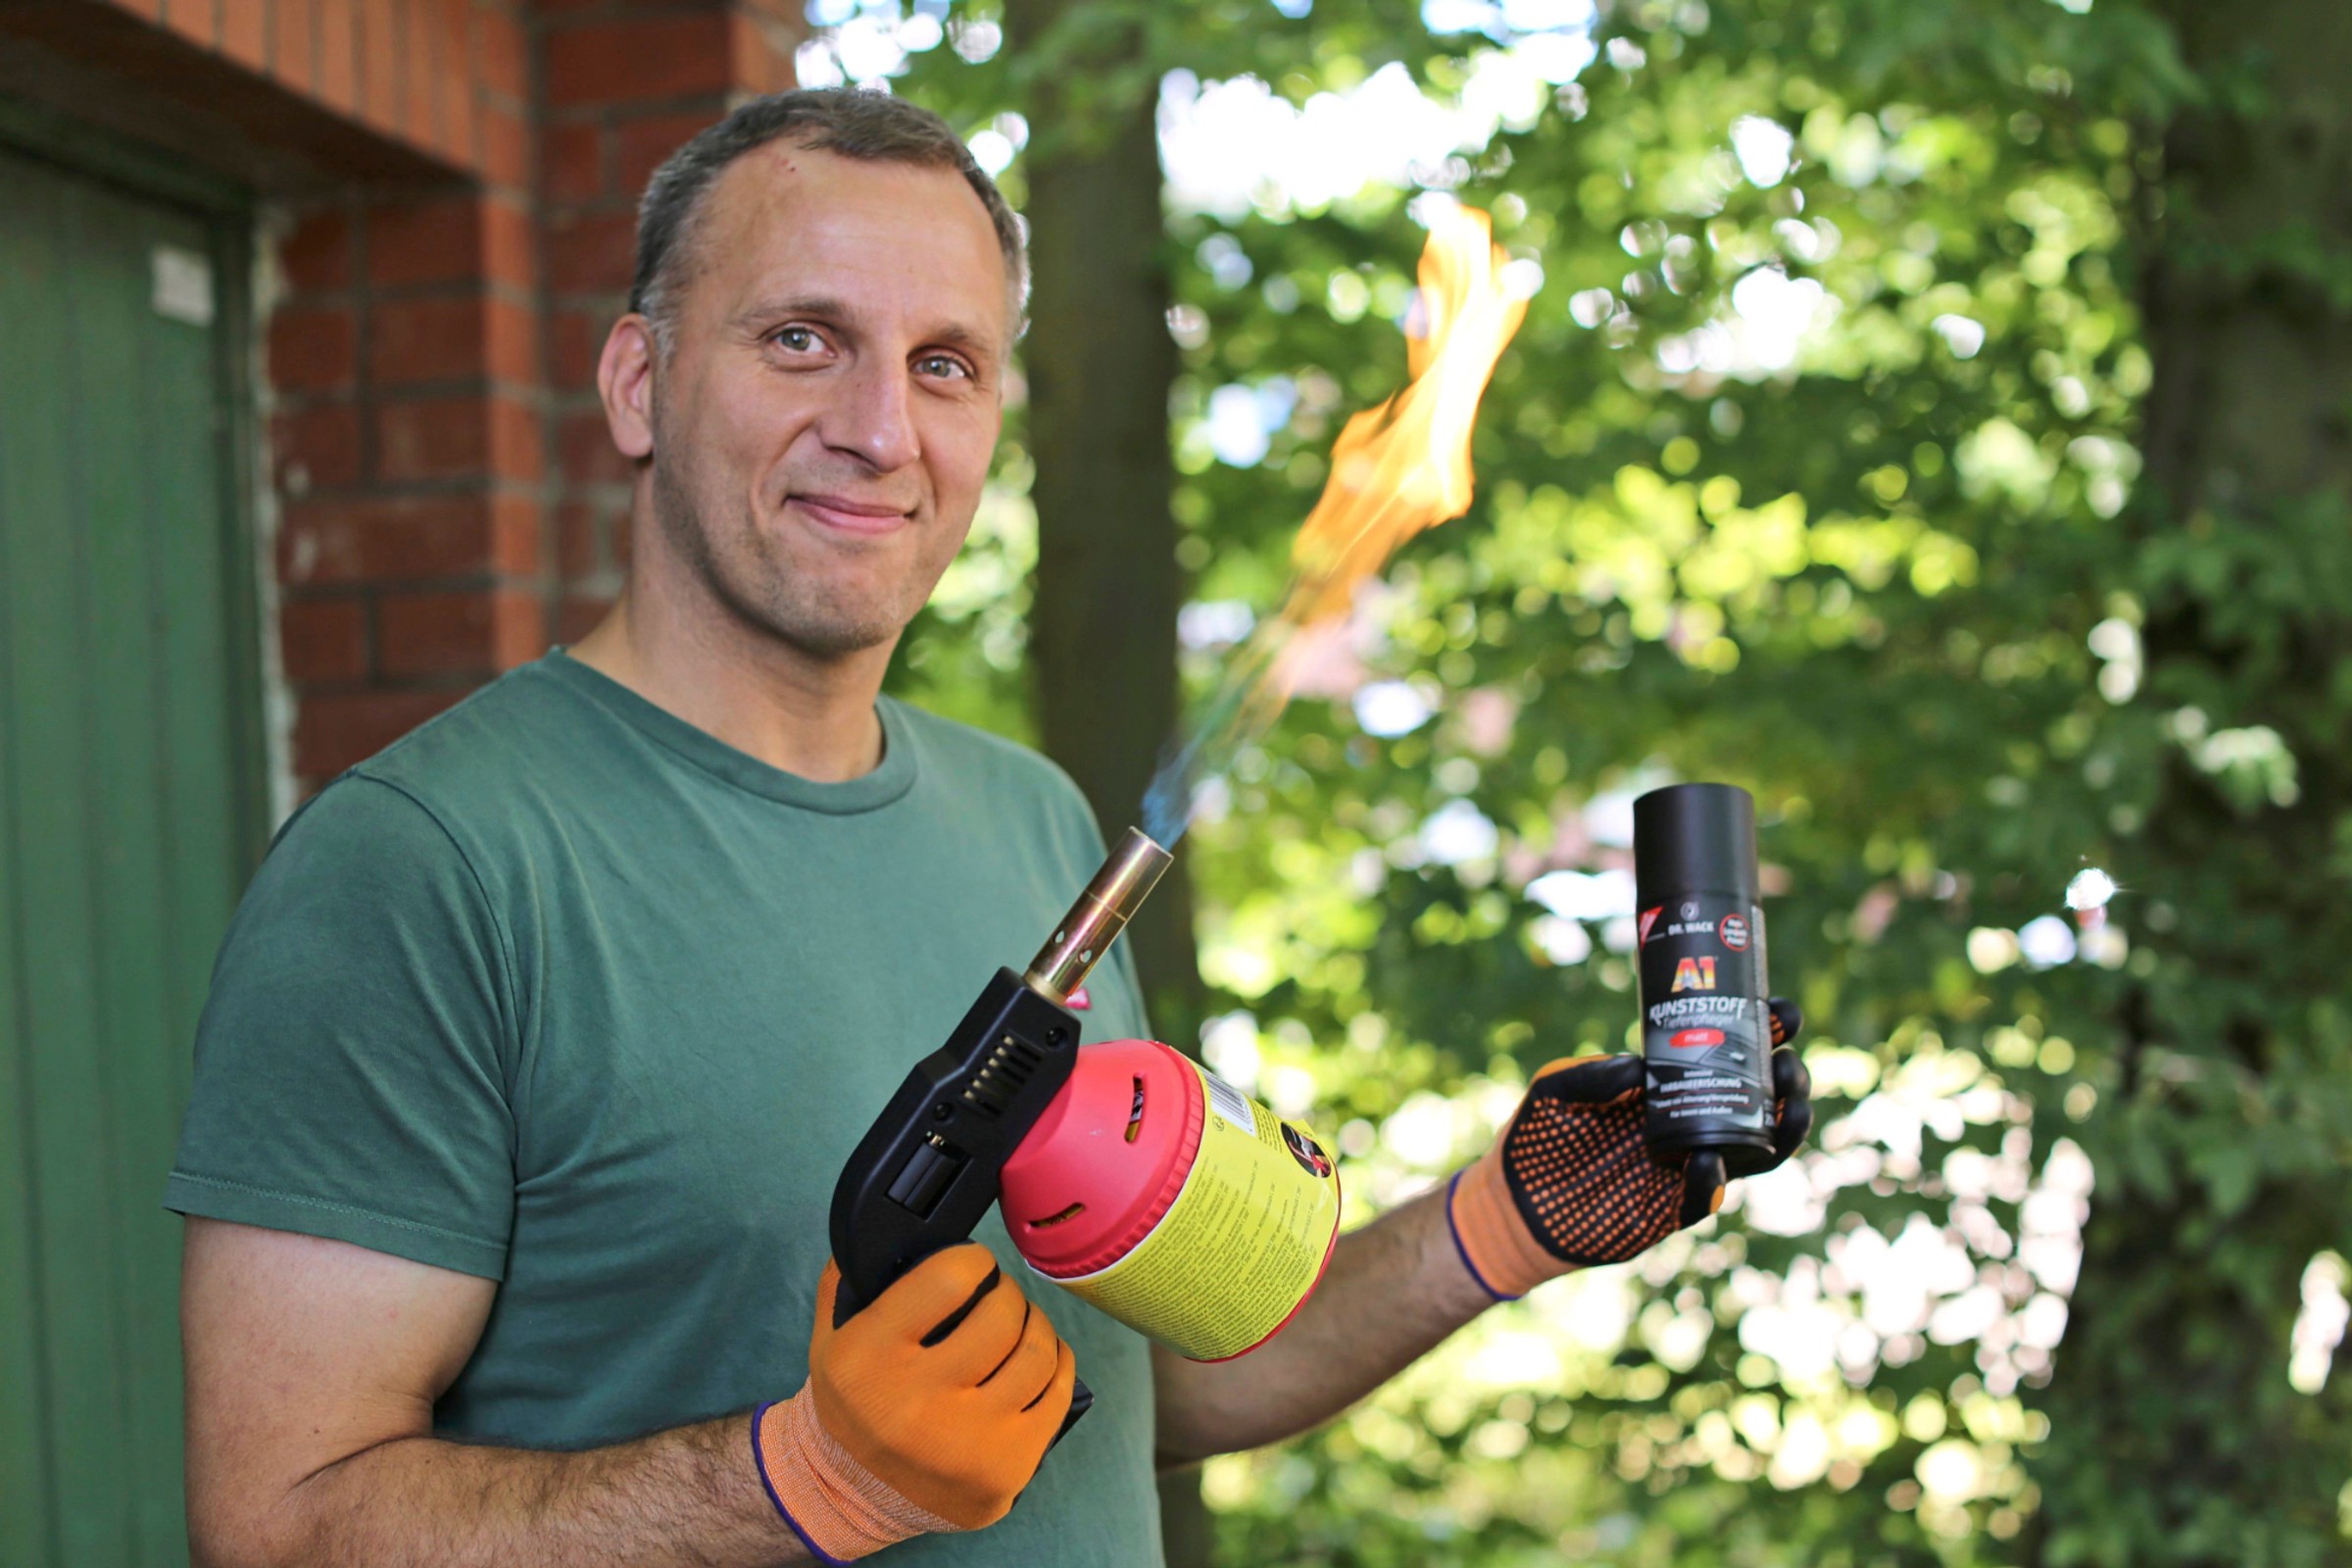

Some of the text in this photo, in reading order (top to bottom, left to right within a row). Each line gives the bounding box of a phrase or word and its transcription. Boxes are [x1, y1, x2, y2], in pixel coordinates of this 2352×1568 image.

[1686, 921, 1715, 934] WACK
[1671, 956, 1715, 993] A1
[1649, 996, 1747, 1026] KUNSTSTOFF
